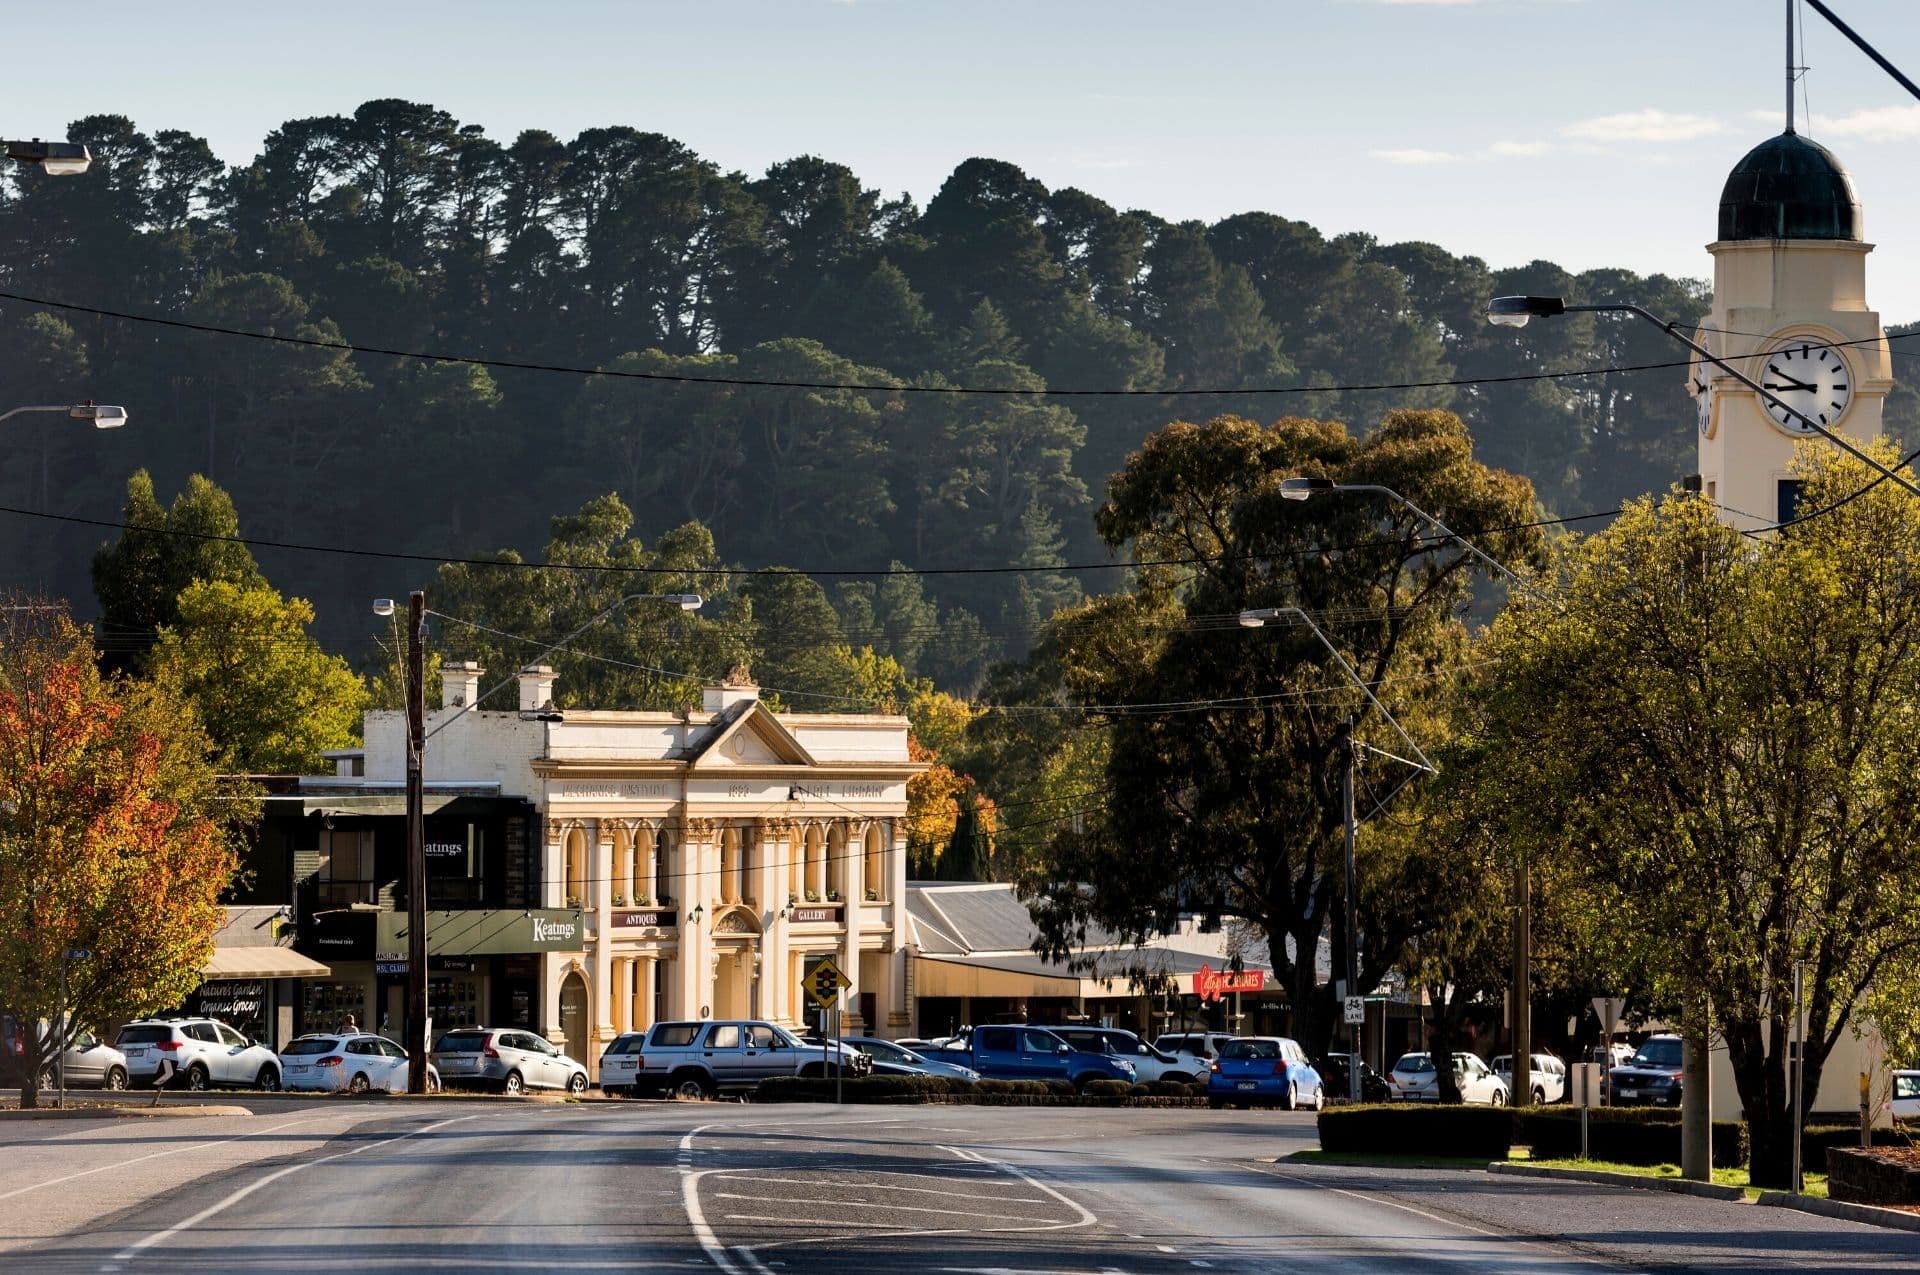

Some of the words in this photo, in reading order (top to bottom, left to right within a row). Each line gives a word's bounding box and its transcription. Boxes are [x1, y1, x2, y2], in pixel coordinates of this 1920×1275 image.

[424, 843, 462, 856] atings
[626, 914, 657, 925] ANTIQUES
[798, 911, 826, 921] GALLERY
[533, 918, 575, 941] Keatings
[376, 964, 388, 973] RSL
[389, 964, 406, 973] CLUB
[200, 983, 231, 997] Nature's
[232, 983, 263, 999] Garden
[200, 1000, 232, 1016] Organic
[233, 1000, 260, 1018] Grocery
